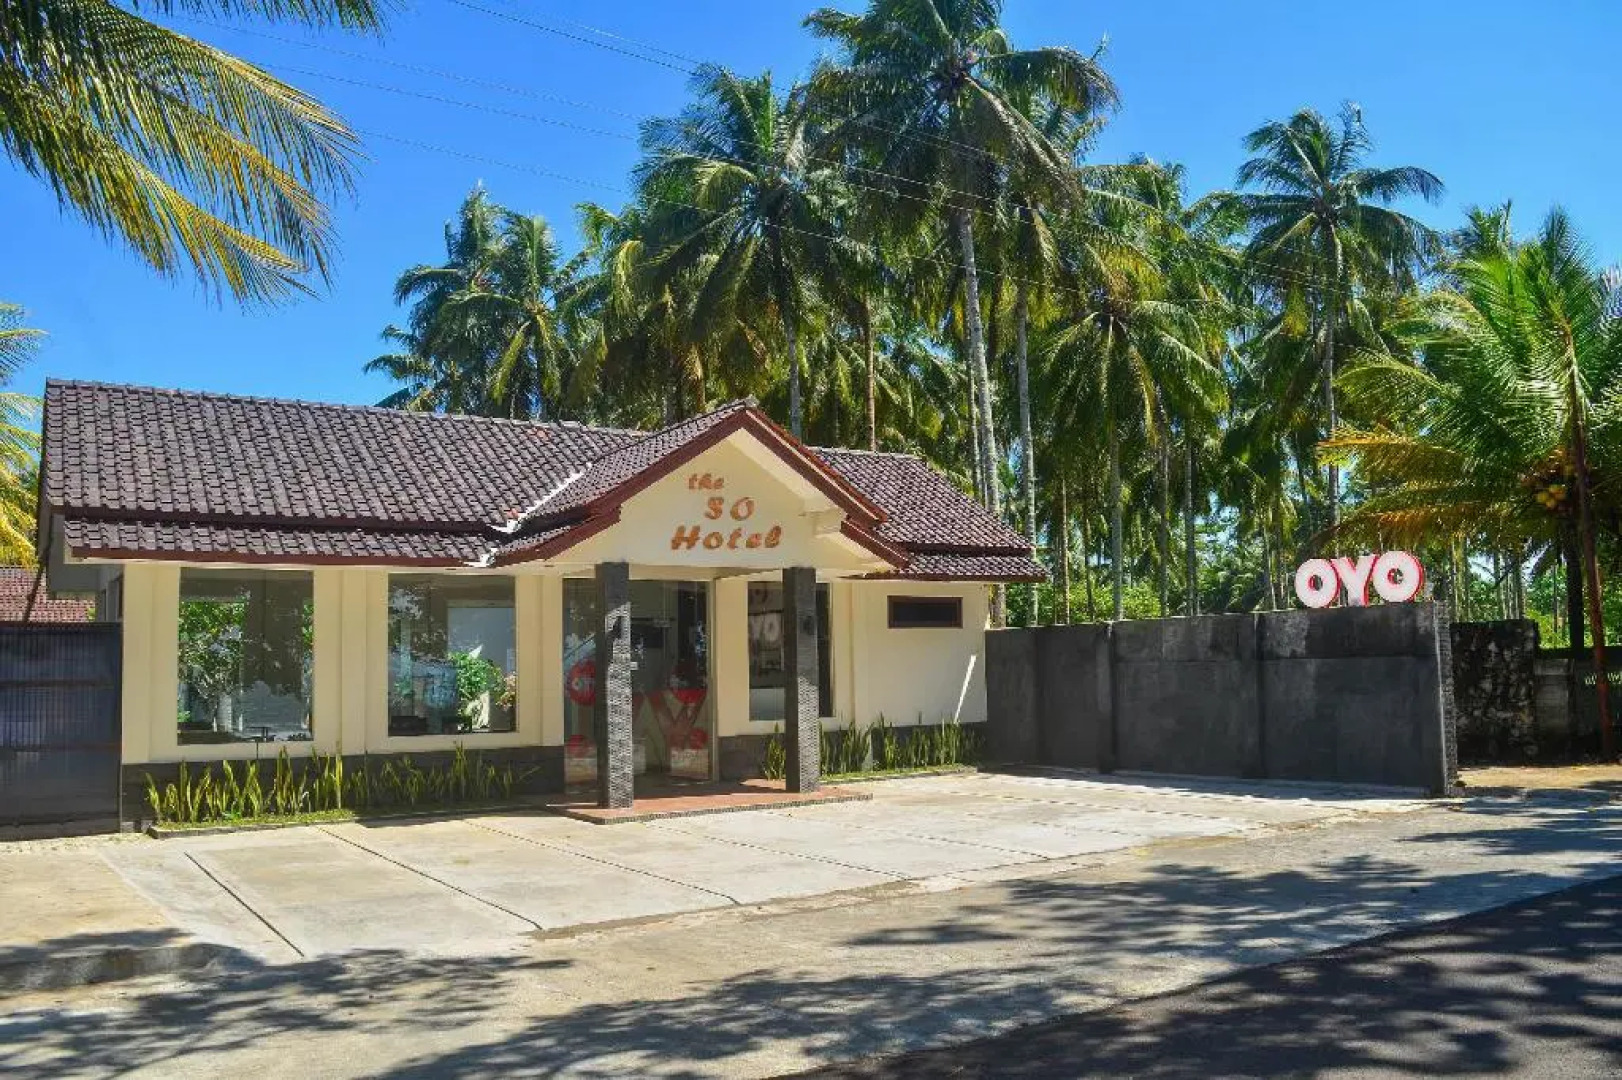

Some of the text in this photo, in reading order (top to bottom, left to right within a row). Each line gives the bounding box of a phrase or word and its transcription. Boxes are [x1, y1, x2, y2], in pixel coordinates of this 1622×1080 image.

[688, 472, 725, 491] the
[671, 525, 783, 550] Hotel
[1294, 550, 1426, 608] OYO
